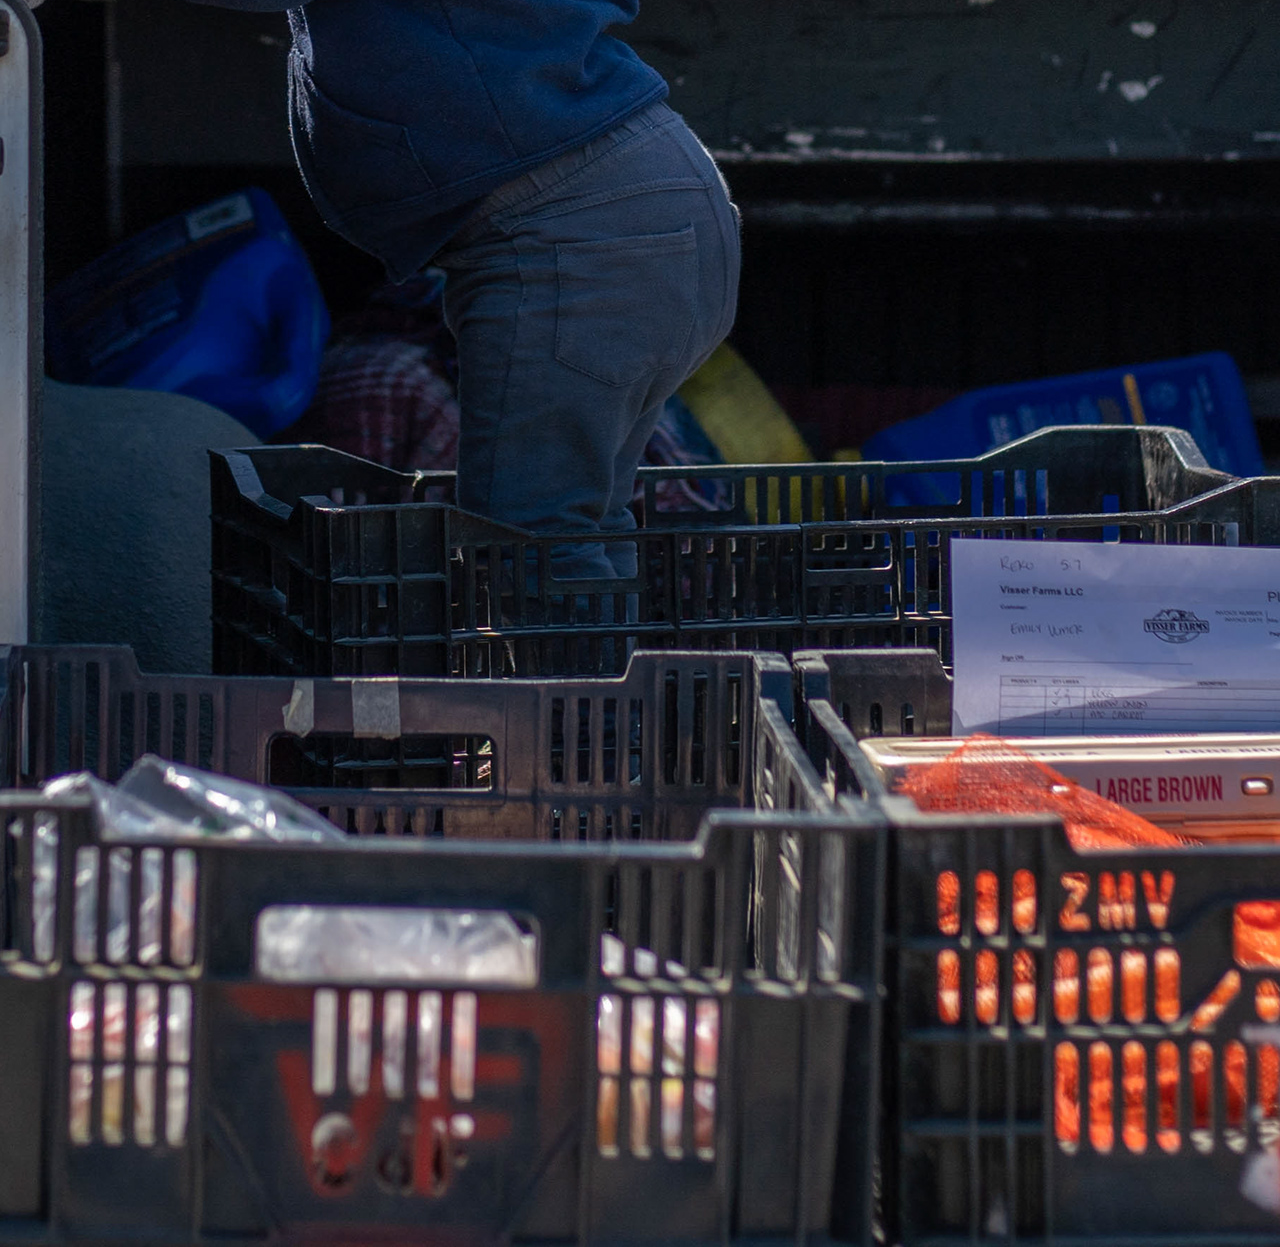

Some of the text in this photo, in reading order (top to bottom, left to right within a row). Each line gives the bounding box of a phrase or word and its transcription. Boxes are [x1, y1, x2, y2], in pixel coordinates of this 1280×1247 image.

[999, 585, 1084, 597] Visser Farms LLC
[1145, 621, 1208, 632] VISSER FARMS
[1096, 774, 1224, 804] LARGE BROWN
